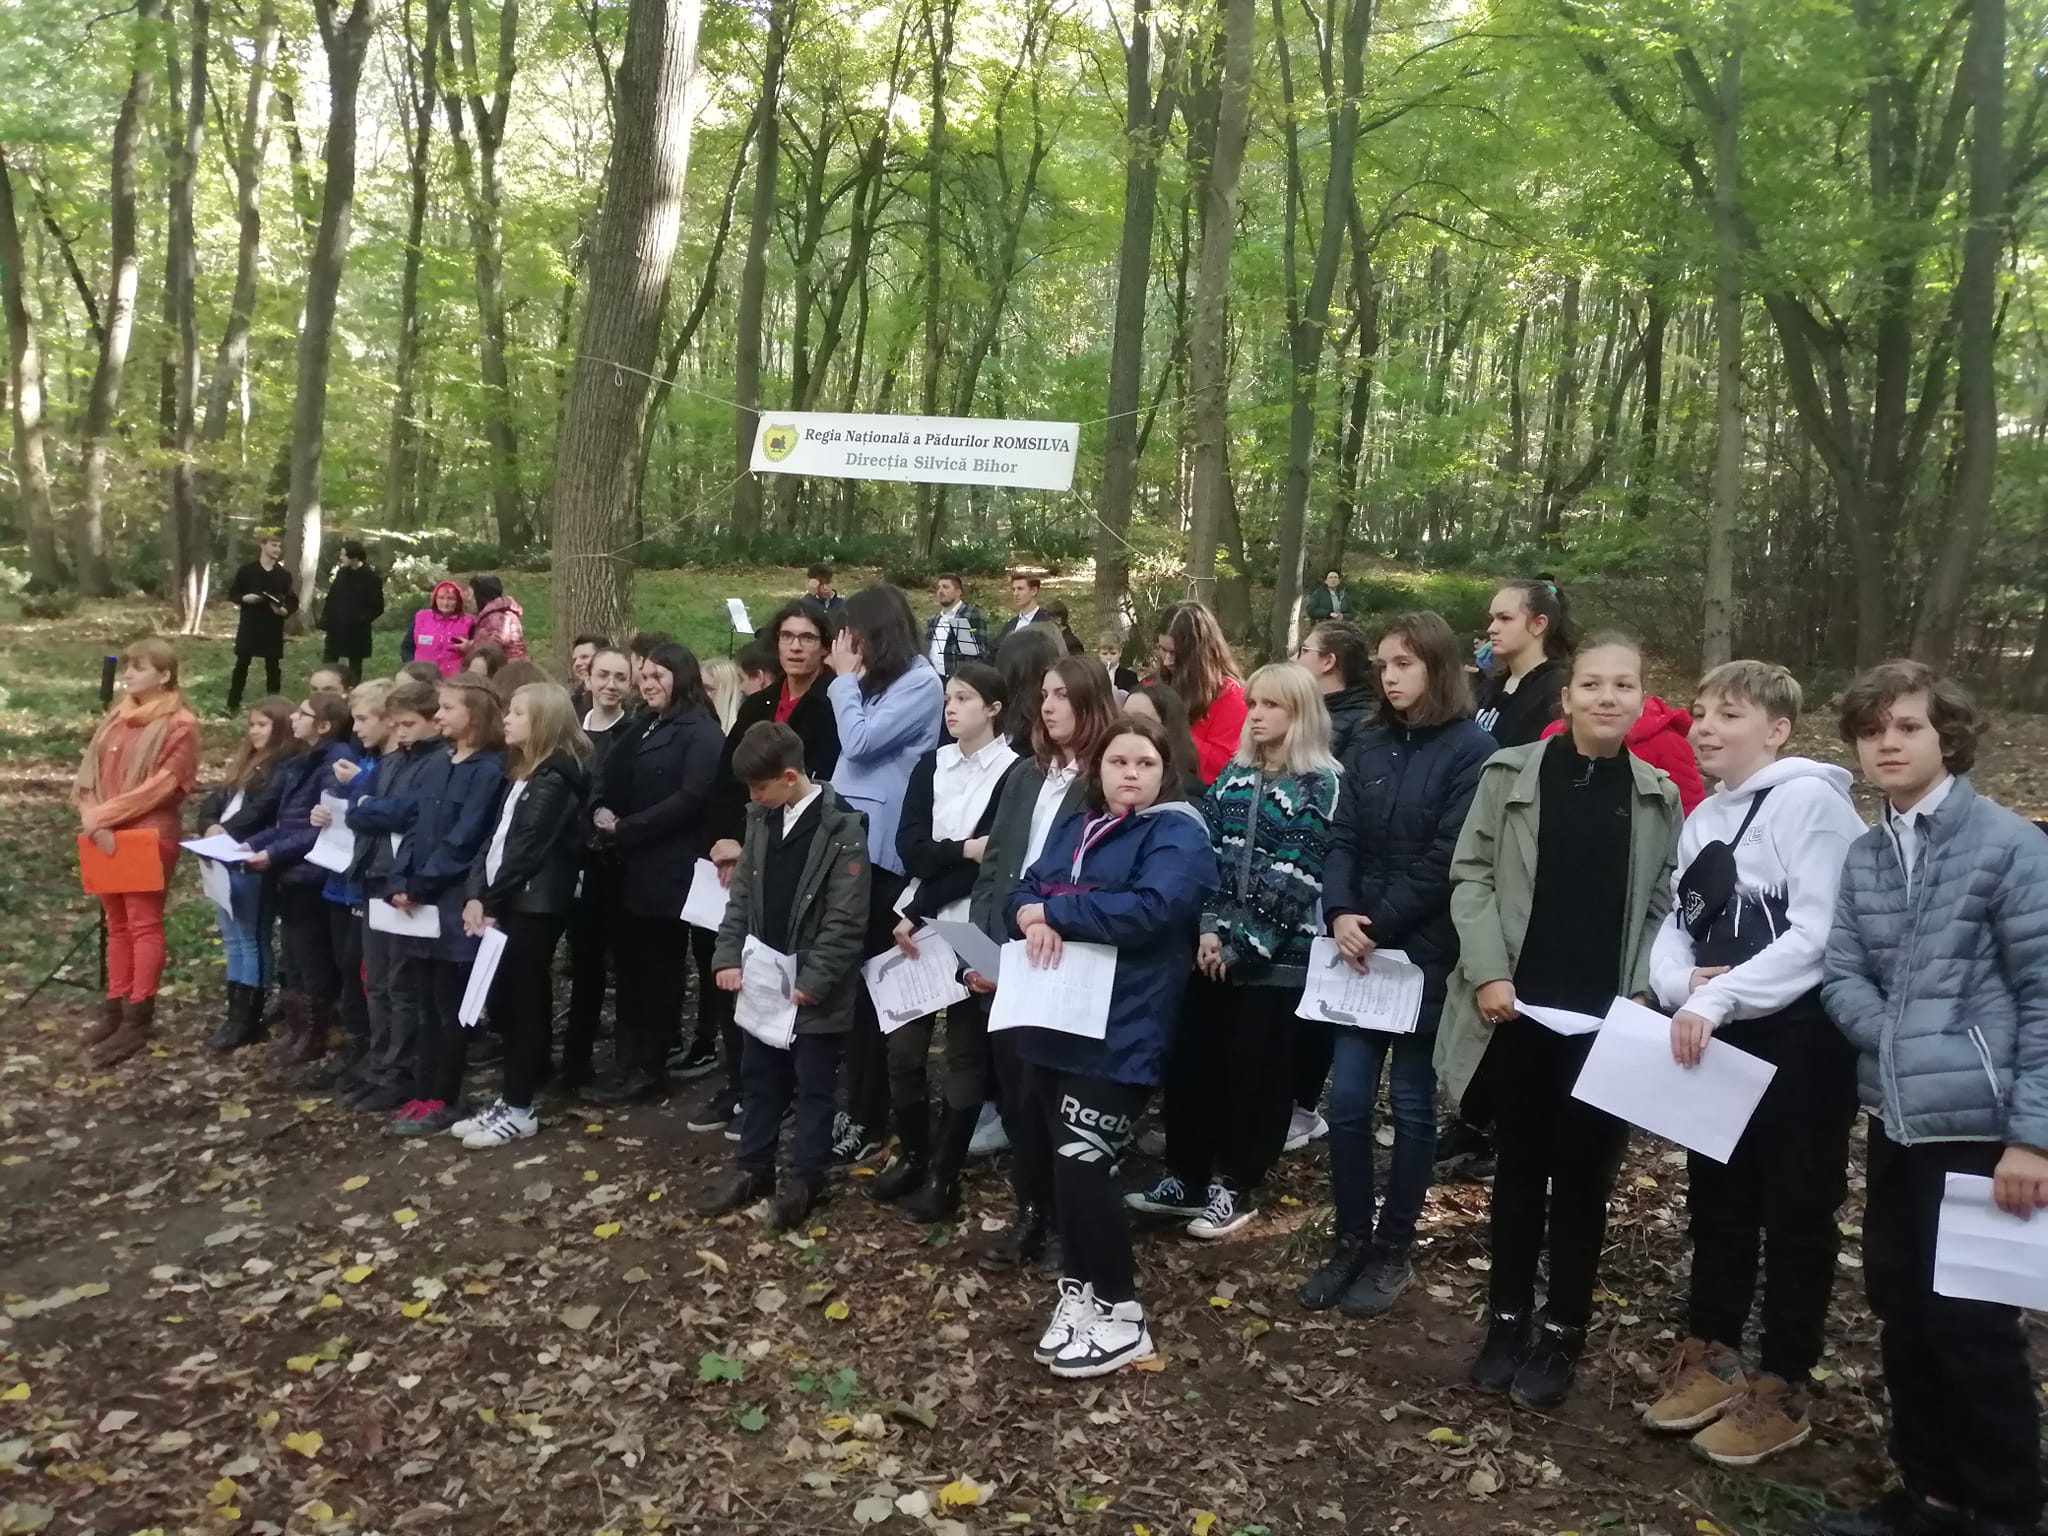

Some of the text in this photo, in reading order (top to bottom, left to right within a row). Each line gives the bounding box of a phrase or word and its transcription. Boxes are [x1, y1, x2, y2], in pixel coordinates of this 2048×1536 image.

[804, 428, 1070, 452] Regia Națională a Pădurilor ROMSILVA
[845, 452, 1018, 474] Direcția Silvică Bihor
